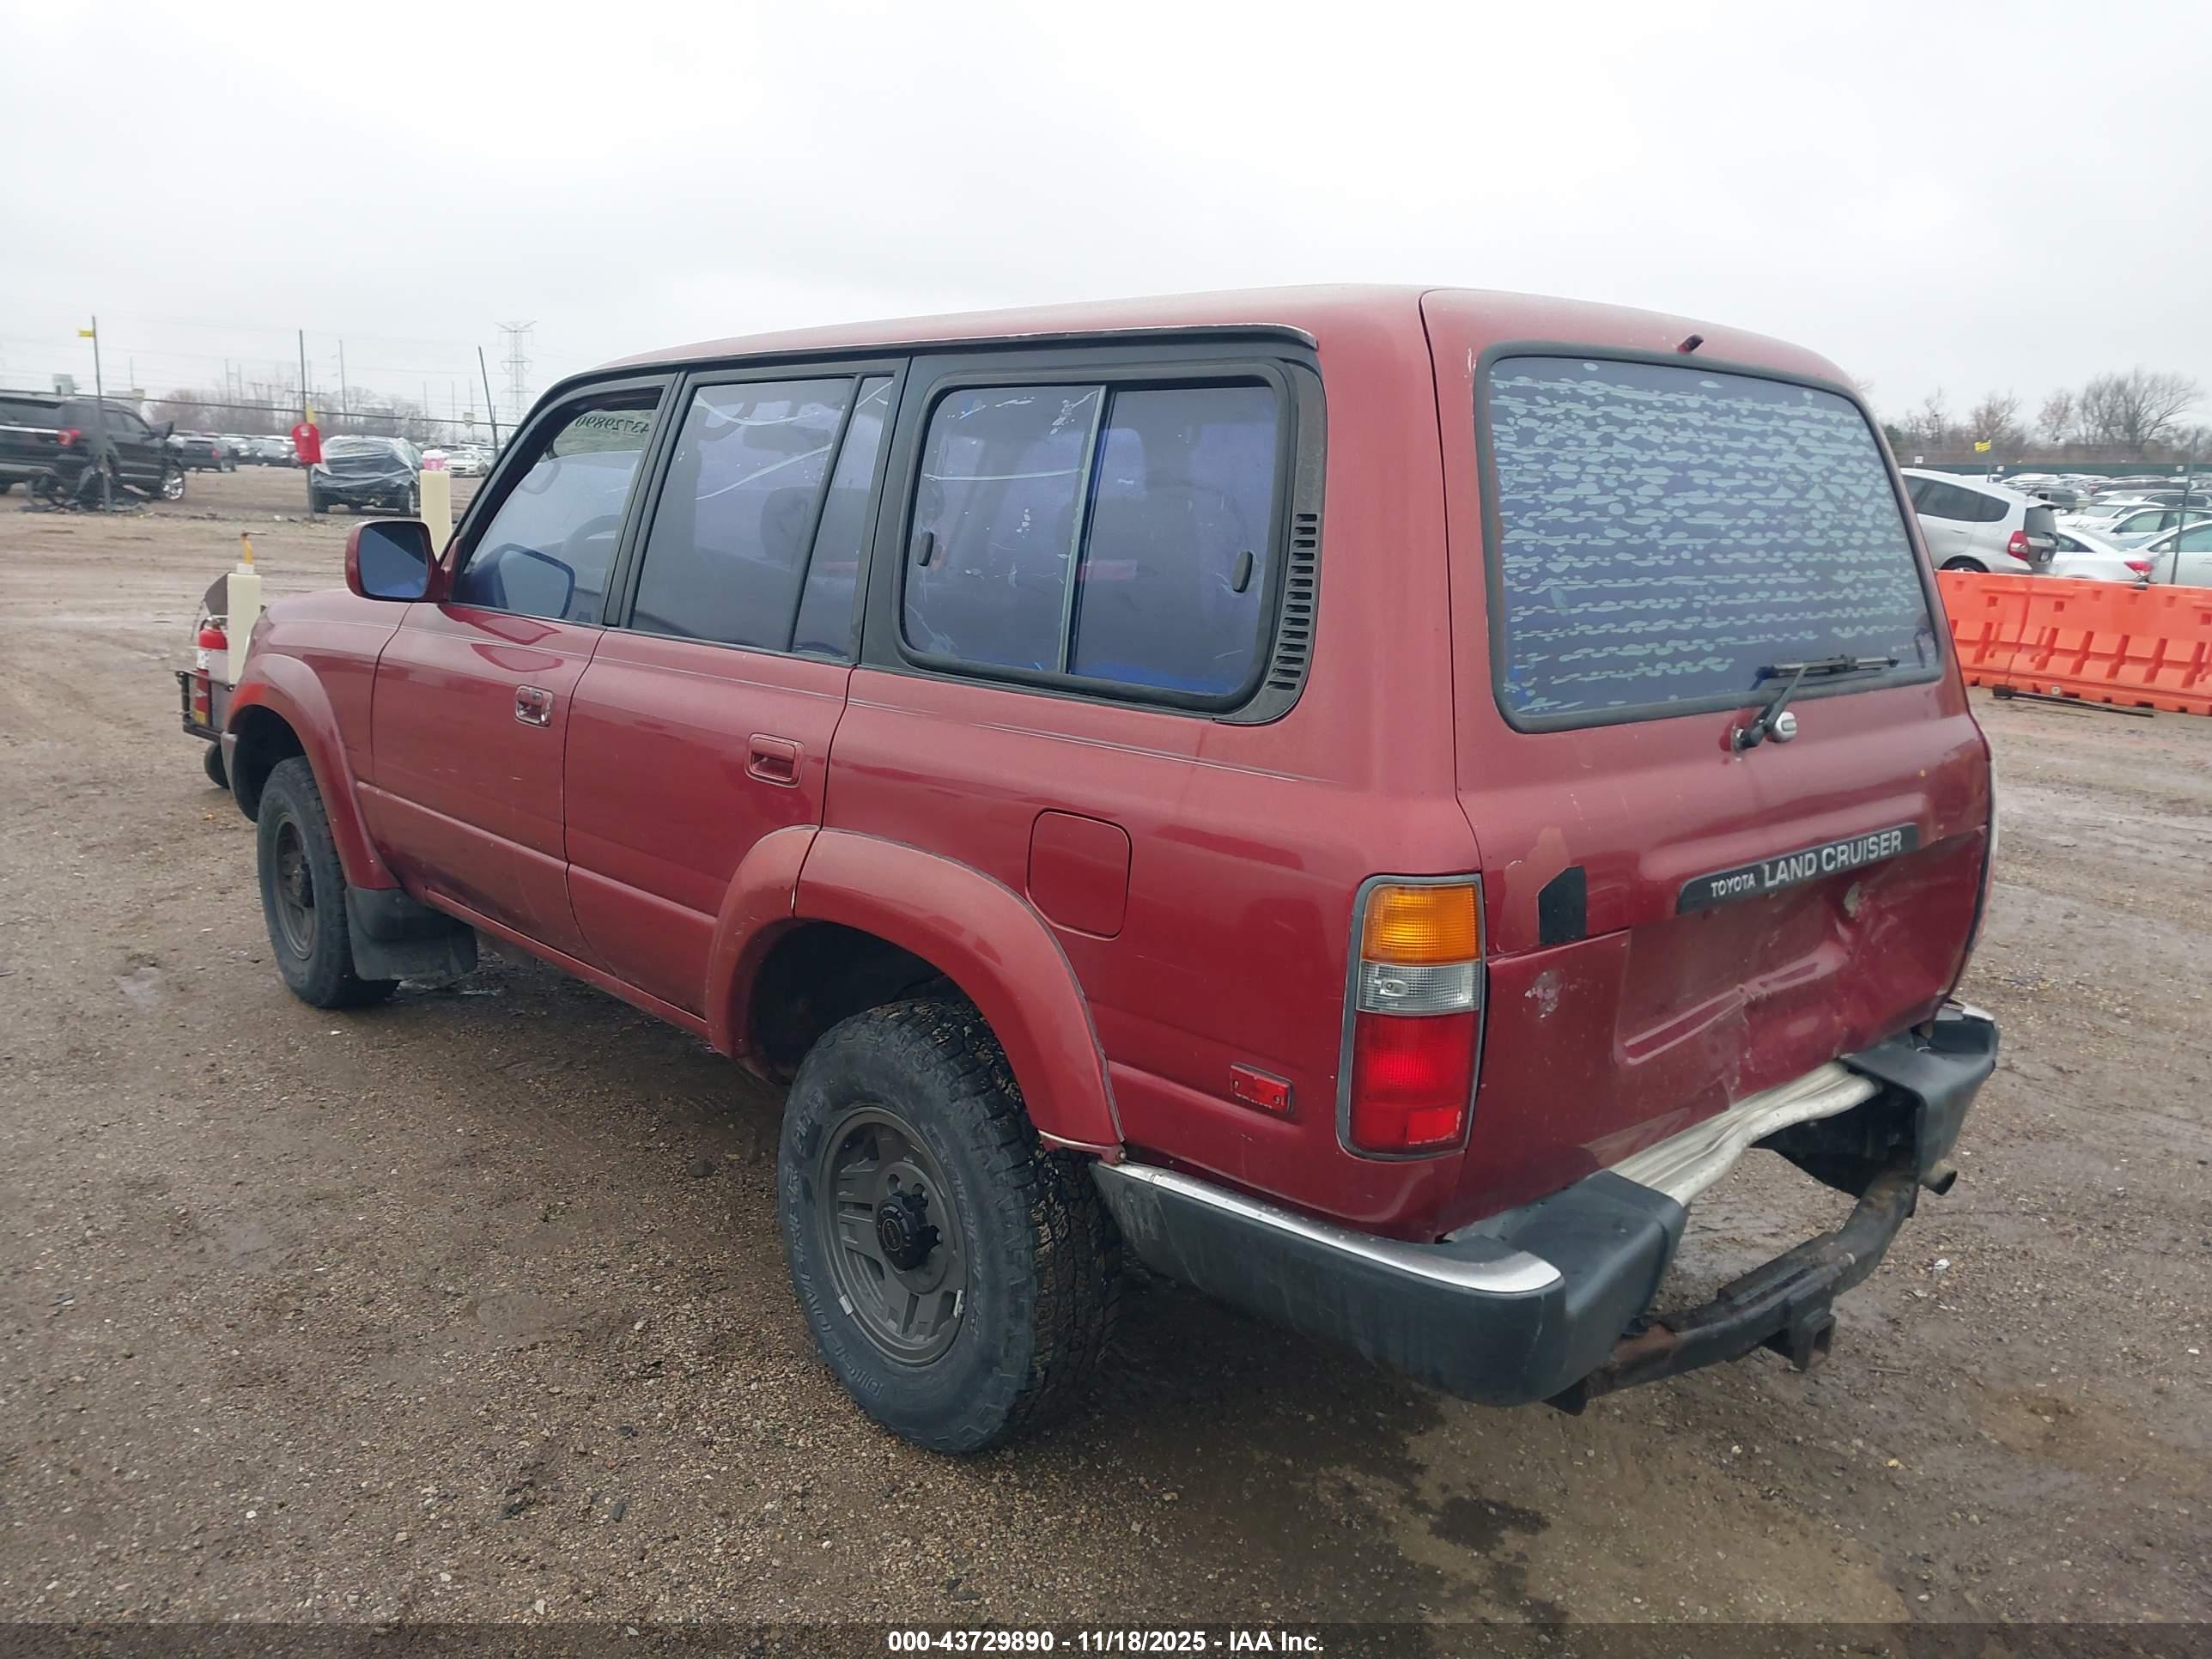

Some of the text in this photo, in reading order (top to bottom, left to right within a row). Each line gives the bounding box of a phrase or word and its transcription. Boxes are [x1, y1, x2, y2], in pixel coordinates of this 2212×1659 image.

[1710, 830, 1903, 898] TOYOTA LAND CRUISER
